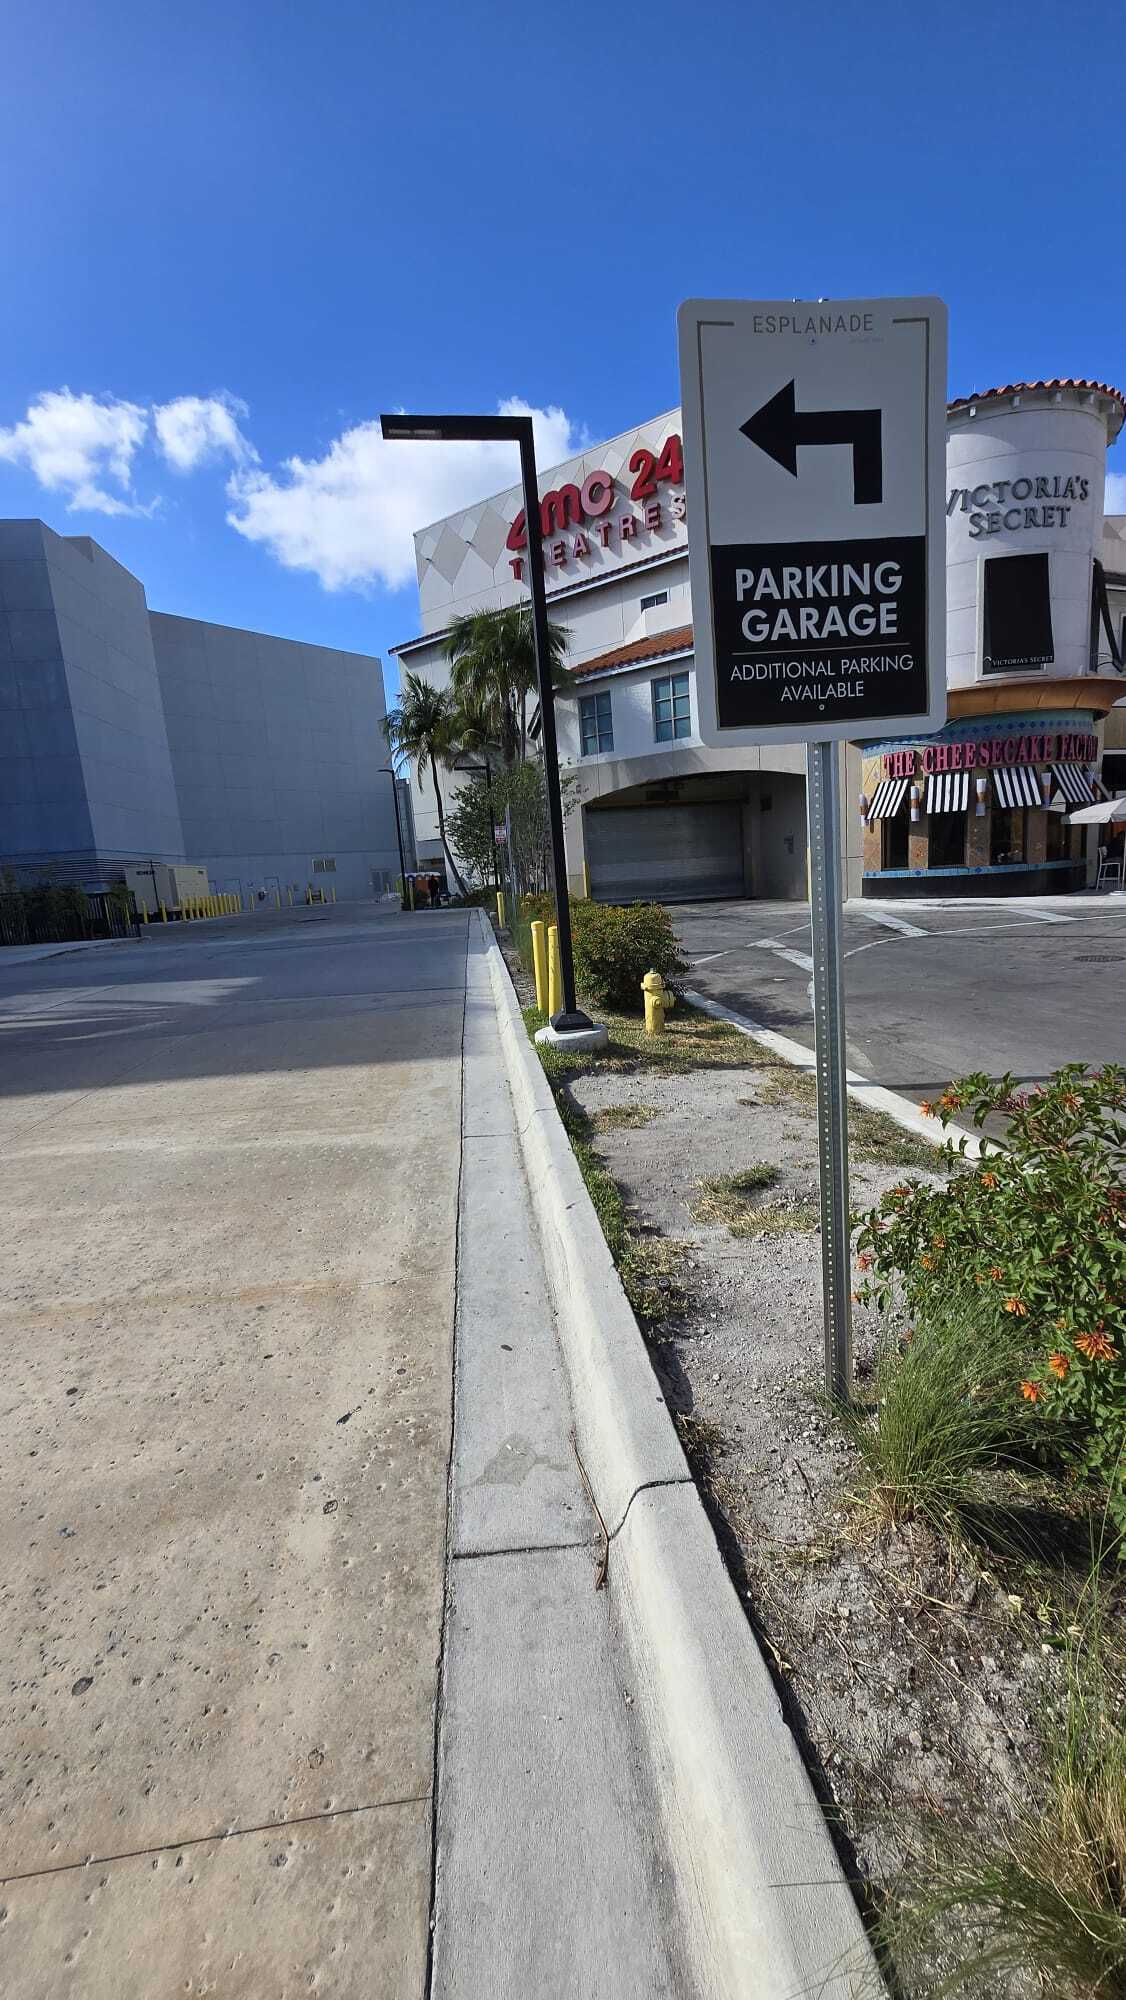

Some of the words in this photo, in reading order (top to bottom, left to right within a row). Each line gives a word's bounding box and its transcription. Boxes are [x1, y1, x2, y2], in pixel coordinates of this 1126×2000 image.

[752, 313, 873, 334] ESPLANADE
[629, 434, 685, 501] 24
[508, 493, 686, 581] TEATRES
[968, 504, 1071, 538] SECRET
[735, 561, 903, 602] PARKING
[741, 601, 898, 642] GARAGE
[730, 659, 836, 682] ADDITIONAL
[841, 654, 914, 675] PARKING
[780, 680, 865, 701] AVAILABLE
[883, 750, 916, 777] THE
[922, 735, 1054, 774] CHEESECAKE
